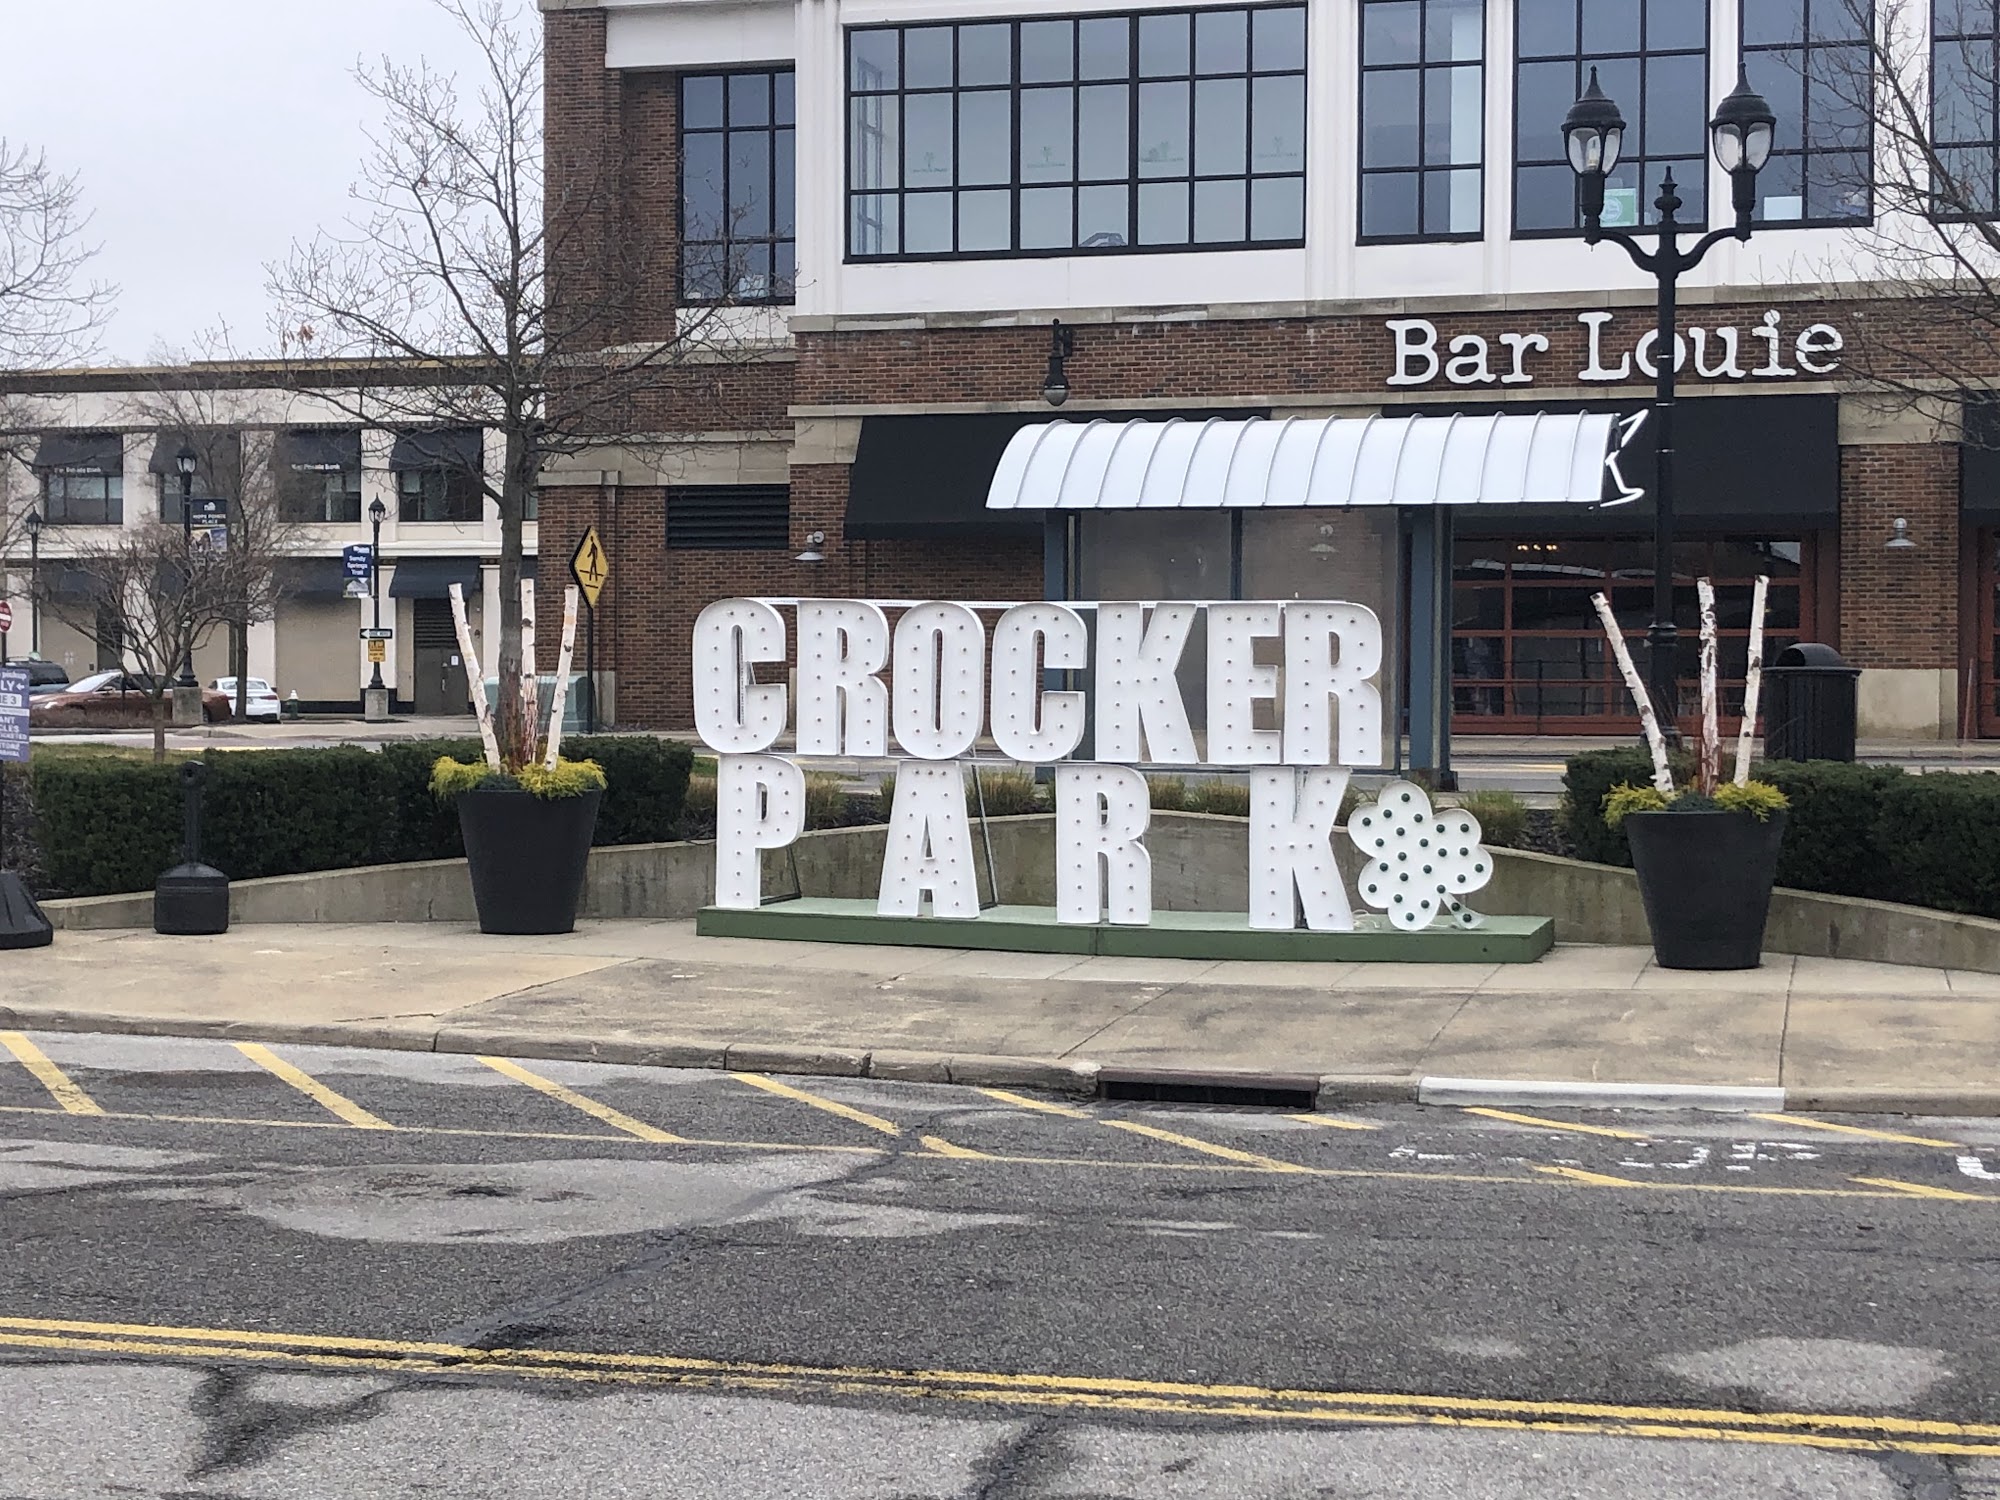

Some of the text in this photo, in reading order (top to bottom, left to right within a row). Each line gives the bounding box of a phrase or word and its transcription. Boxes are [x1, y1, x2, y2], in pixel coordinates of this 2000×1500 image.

[1385, 309, 1844, 386] Bar Louie
[10, 695, 17, 705] 3
[692, 597, 1384, 766] CROCKER
[714, 754, 1355, 932] PARK
